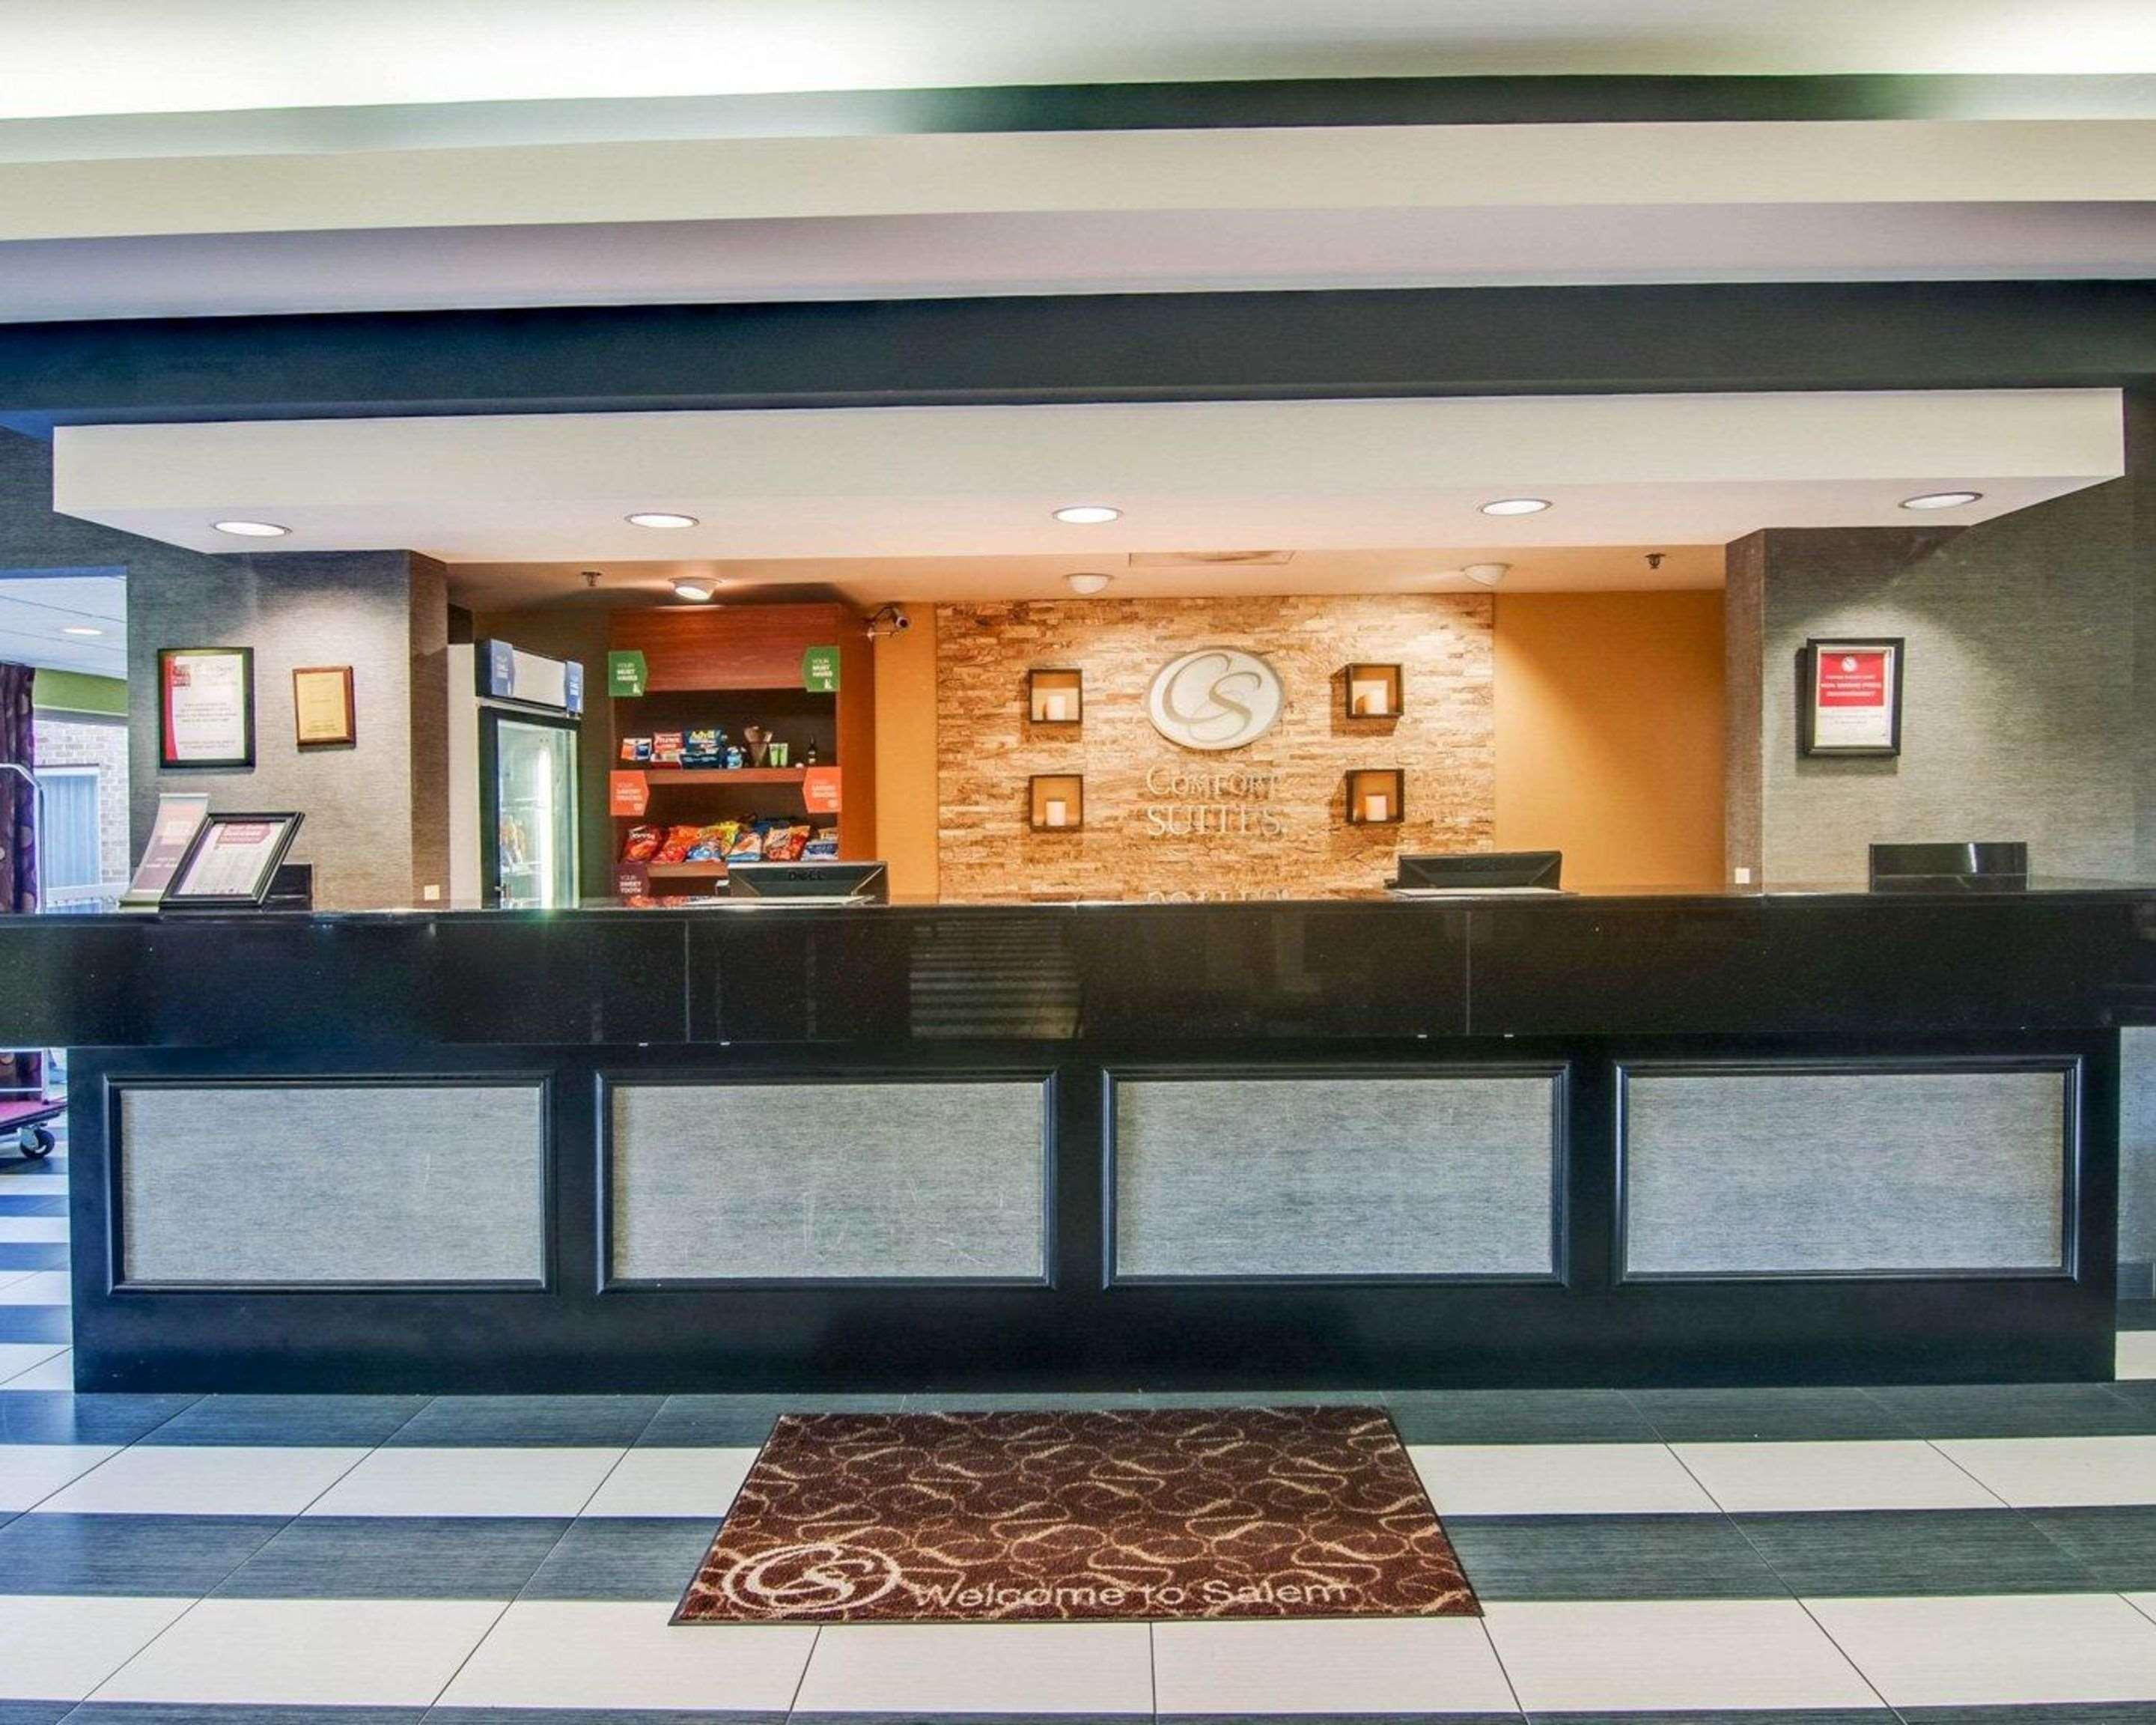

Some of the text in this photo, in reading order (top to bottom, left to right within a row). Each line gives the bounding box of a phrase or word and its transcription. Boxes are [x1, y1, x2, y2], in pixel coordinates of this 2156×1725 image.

[1145, 803, 1283, 836] SUITES
[915, 1578, 1349, 1607] Welcome to Salem
